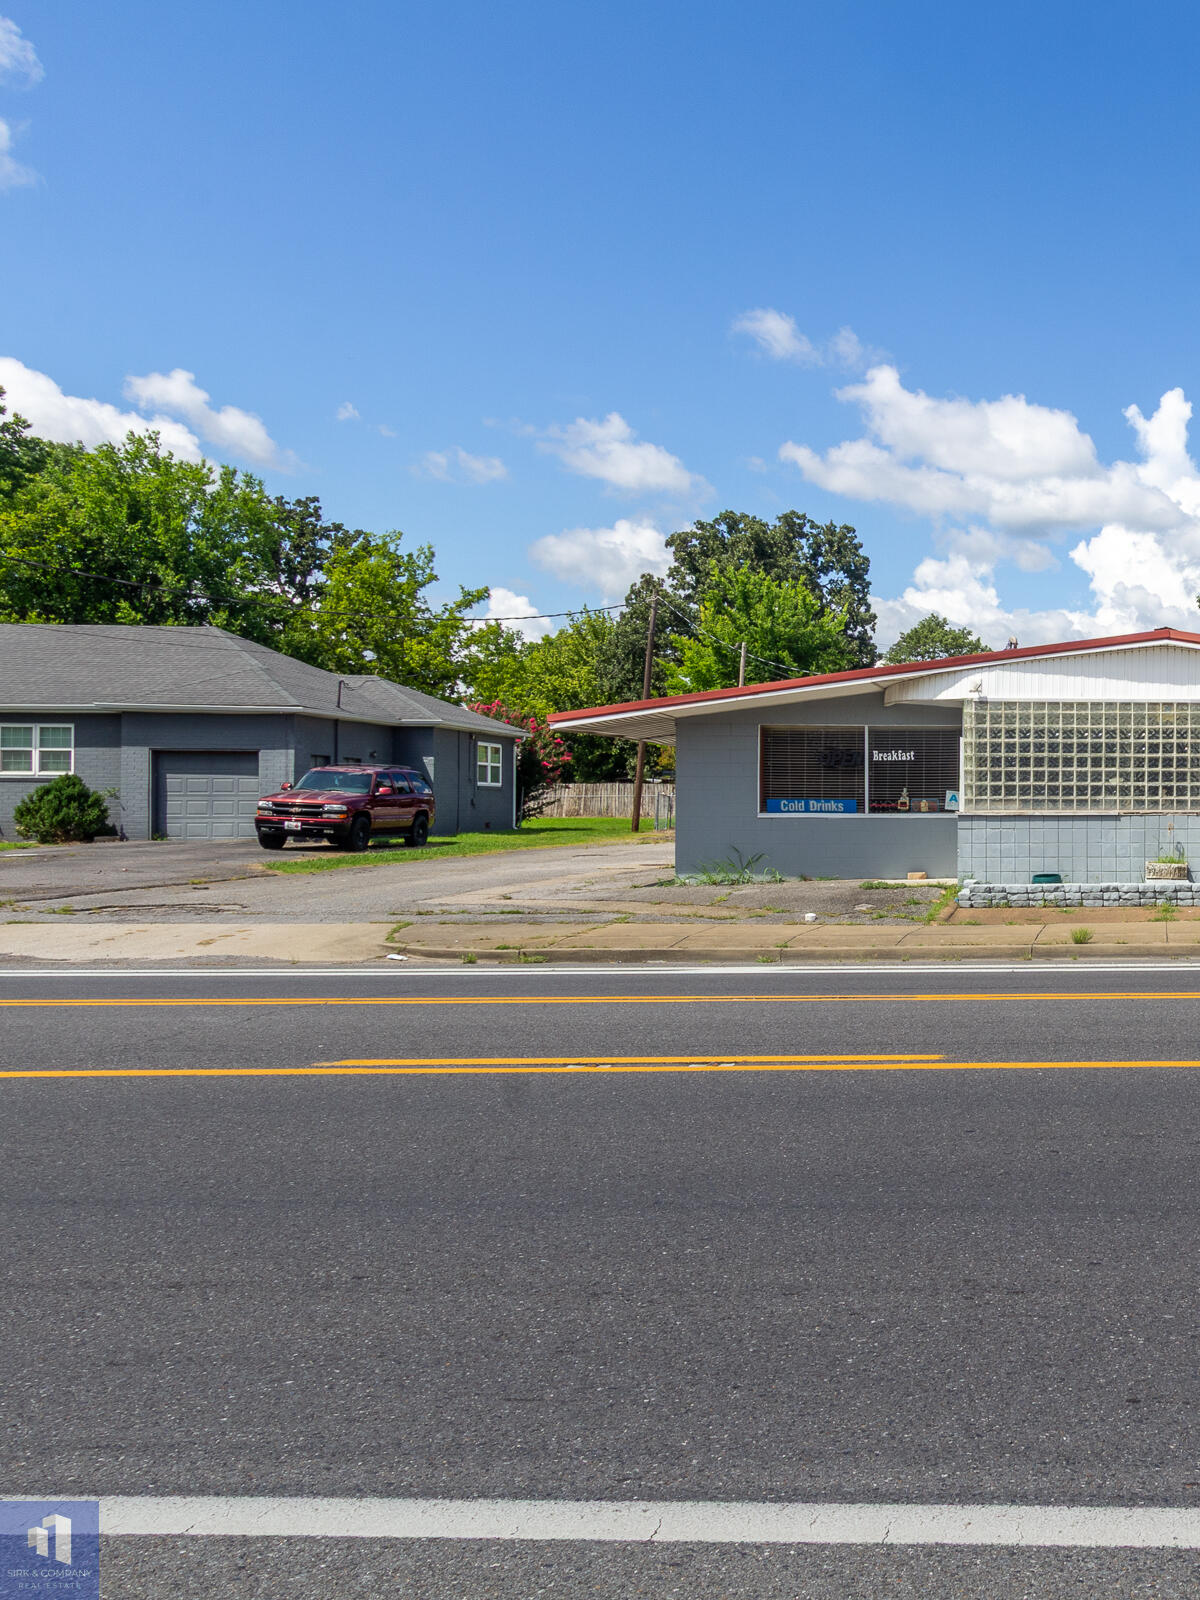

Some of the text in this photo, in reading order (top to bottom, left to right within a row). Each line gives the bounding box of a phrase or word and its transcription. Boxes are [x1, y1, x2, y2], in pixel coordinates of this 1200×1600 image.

[873, 750, 915, 761] Breakfast
[780, 800, 844, 812] Cold Drinks
